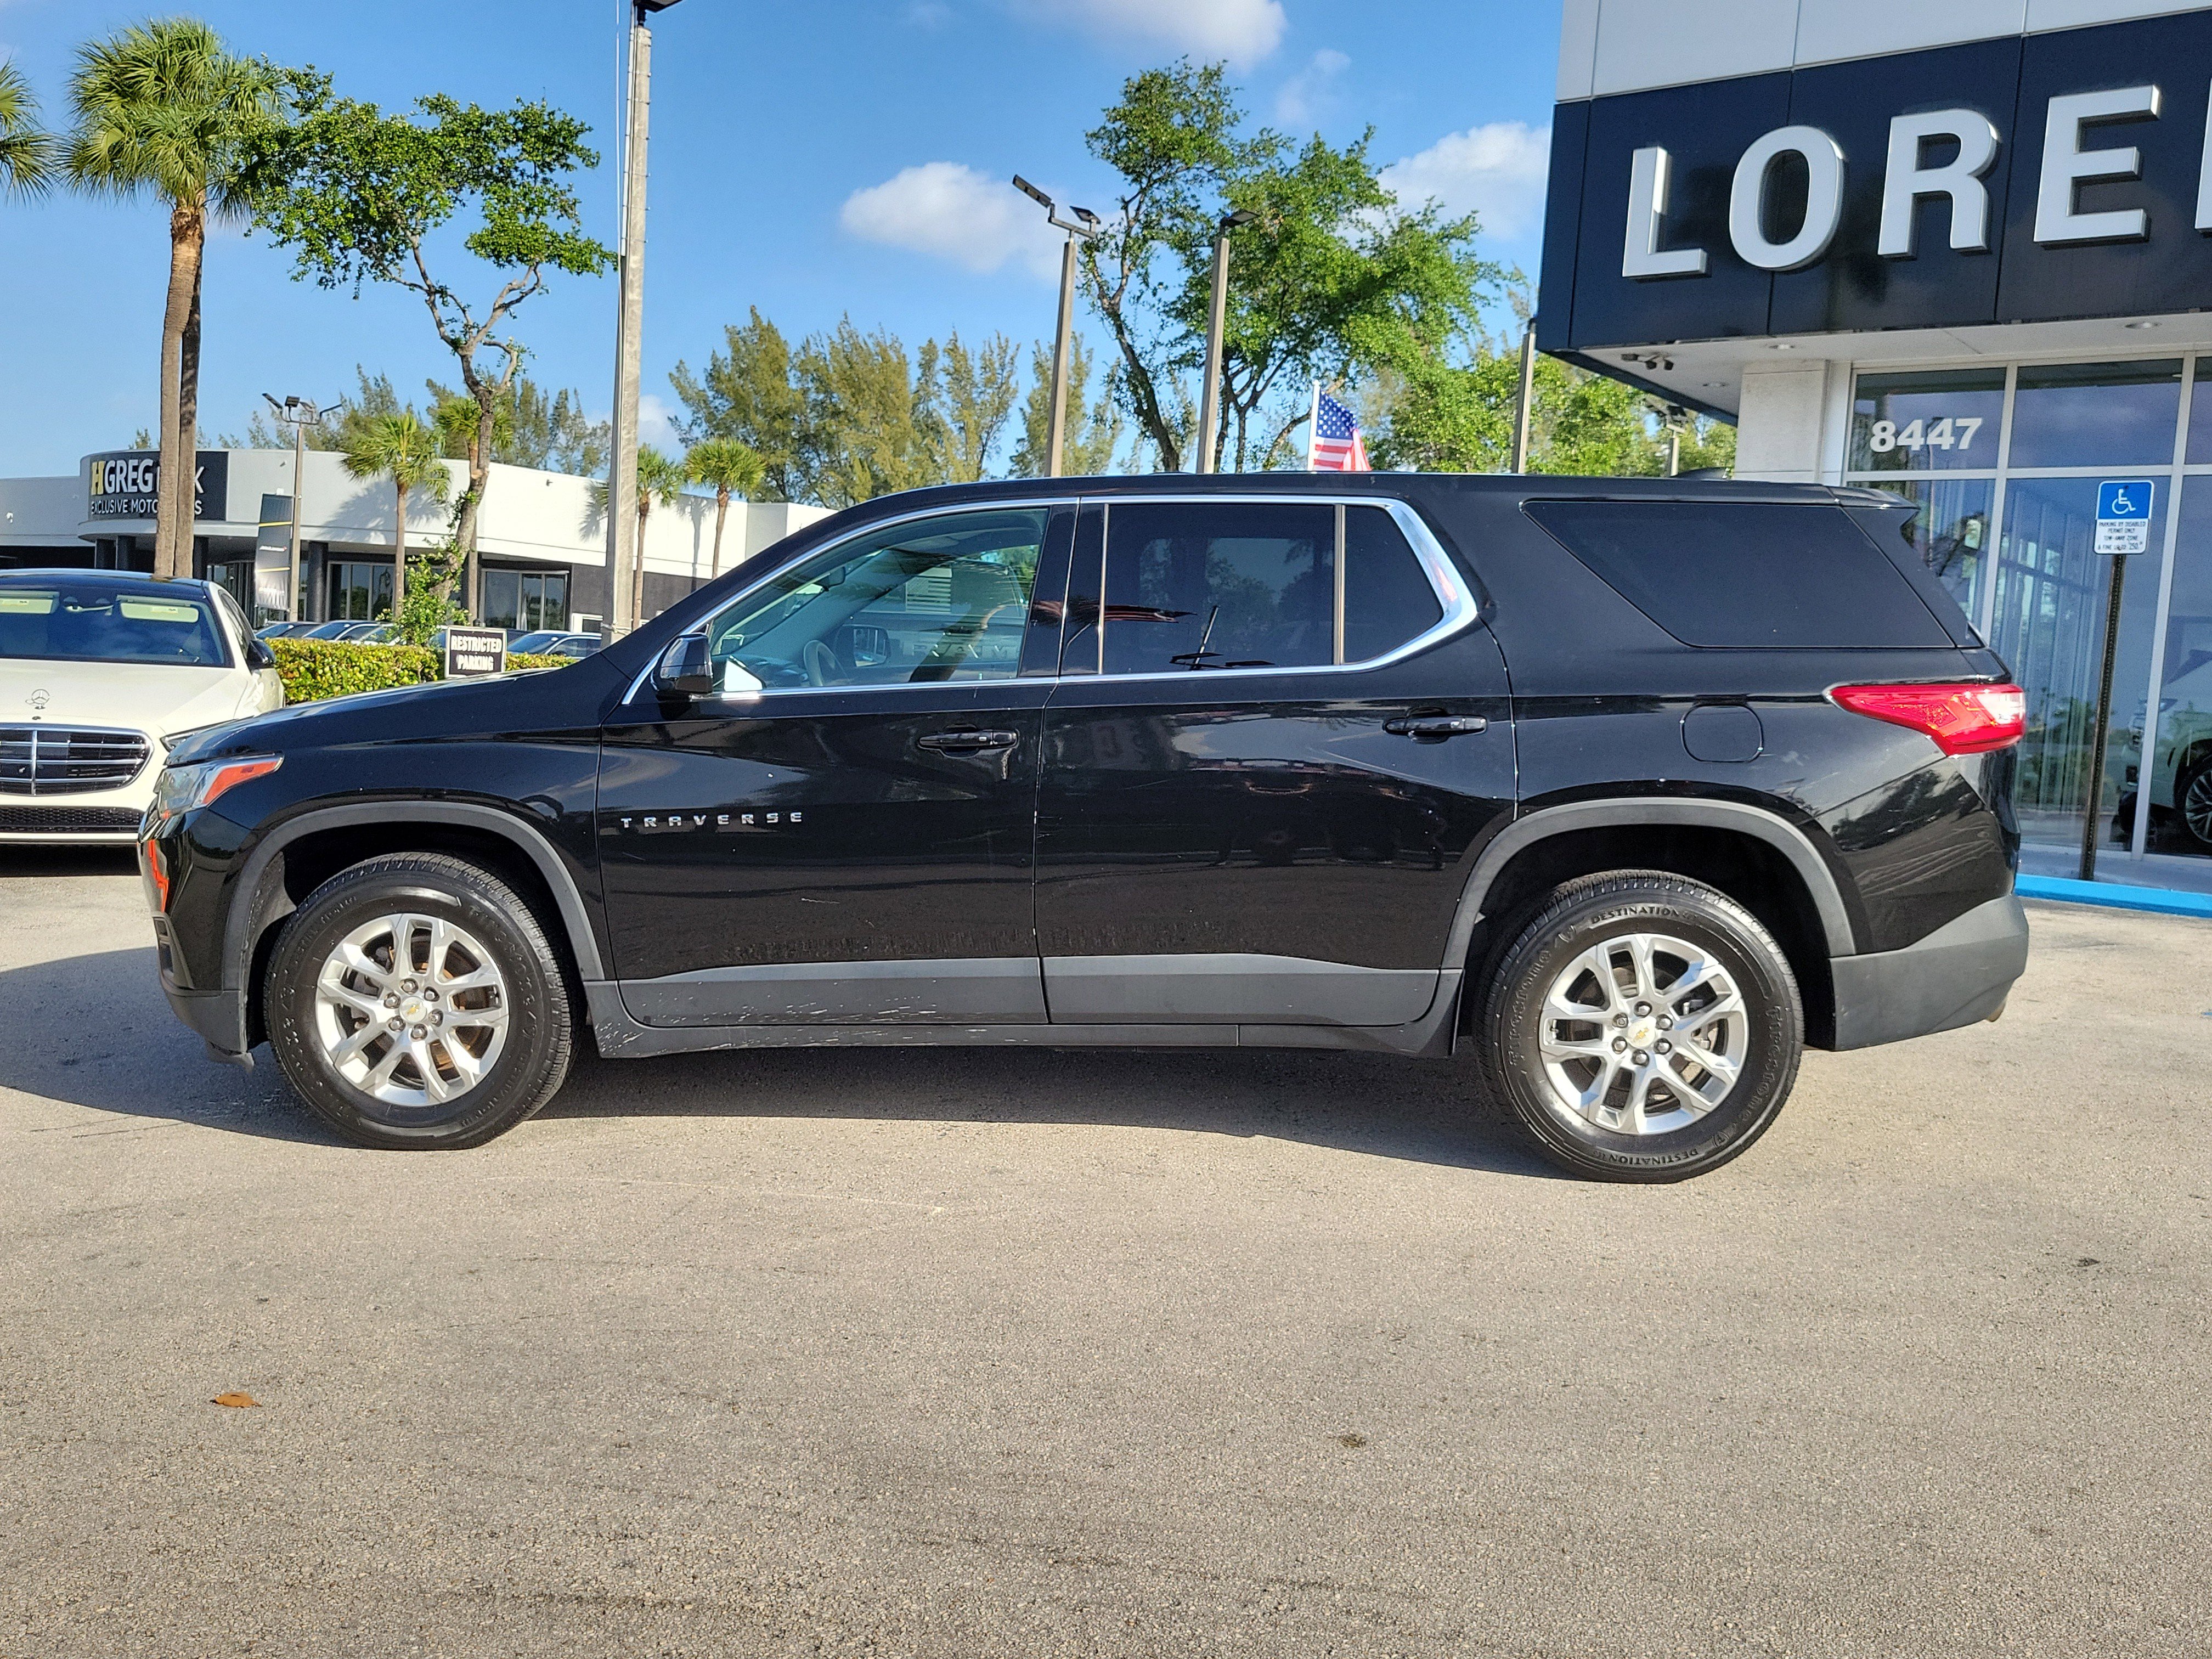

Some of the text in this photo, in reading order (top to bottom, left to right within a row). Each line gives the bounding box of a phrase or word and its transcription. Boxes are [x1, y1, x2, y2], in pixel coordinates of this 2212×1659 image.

[1622, 78, 2212, 282] LORE
[1870, 417, 1983, 453] 8447
[91, 499, 128, 515] EXCLUSIVE
[451, 635, 503, 653] RESTRICTED
[456, 654, 494, 672] PARKING
[620, 811, 802, 828] TRAVERSE
[1592, 906, 1679, 925] DESTINATION
[1609, 1148, 1699, 1165] DESTINATION
